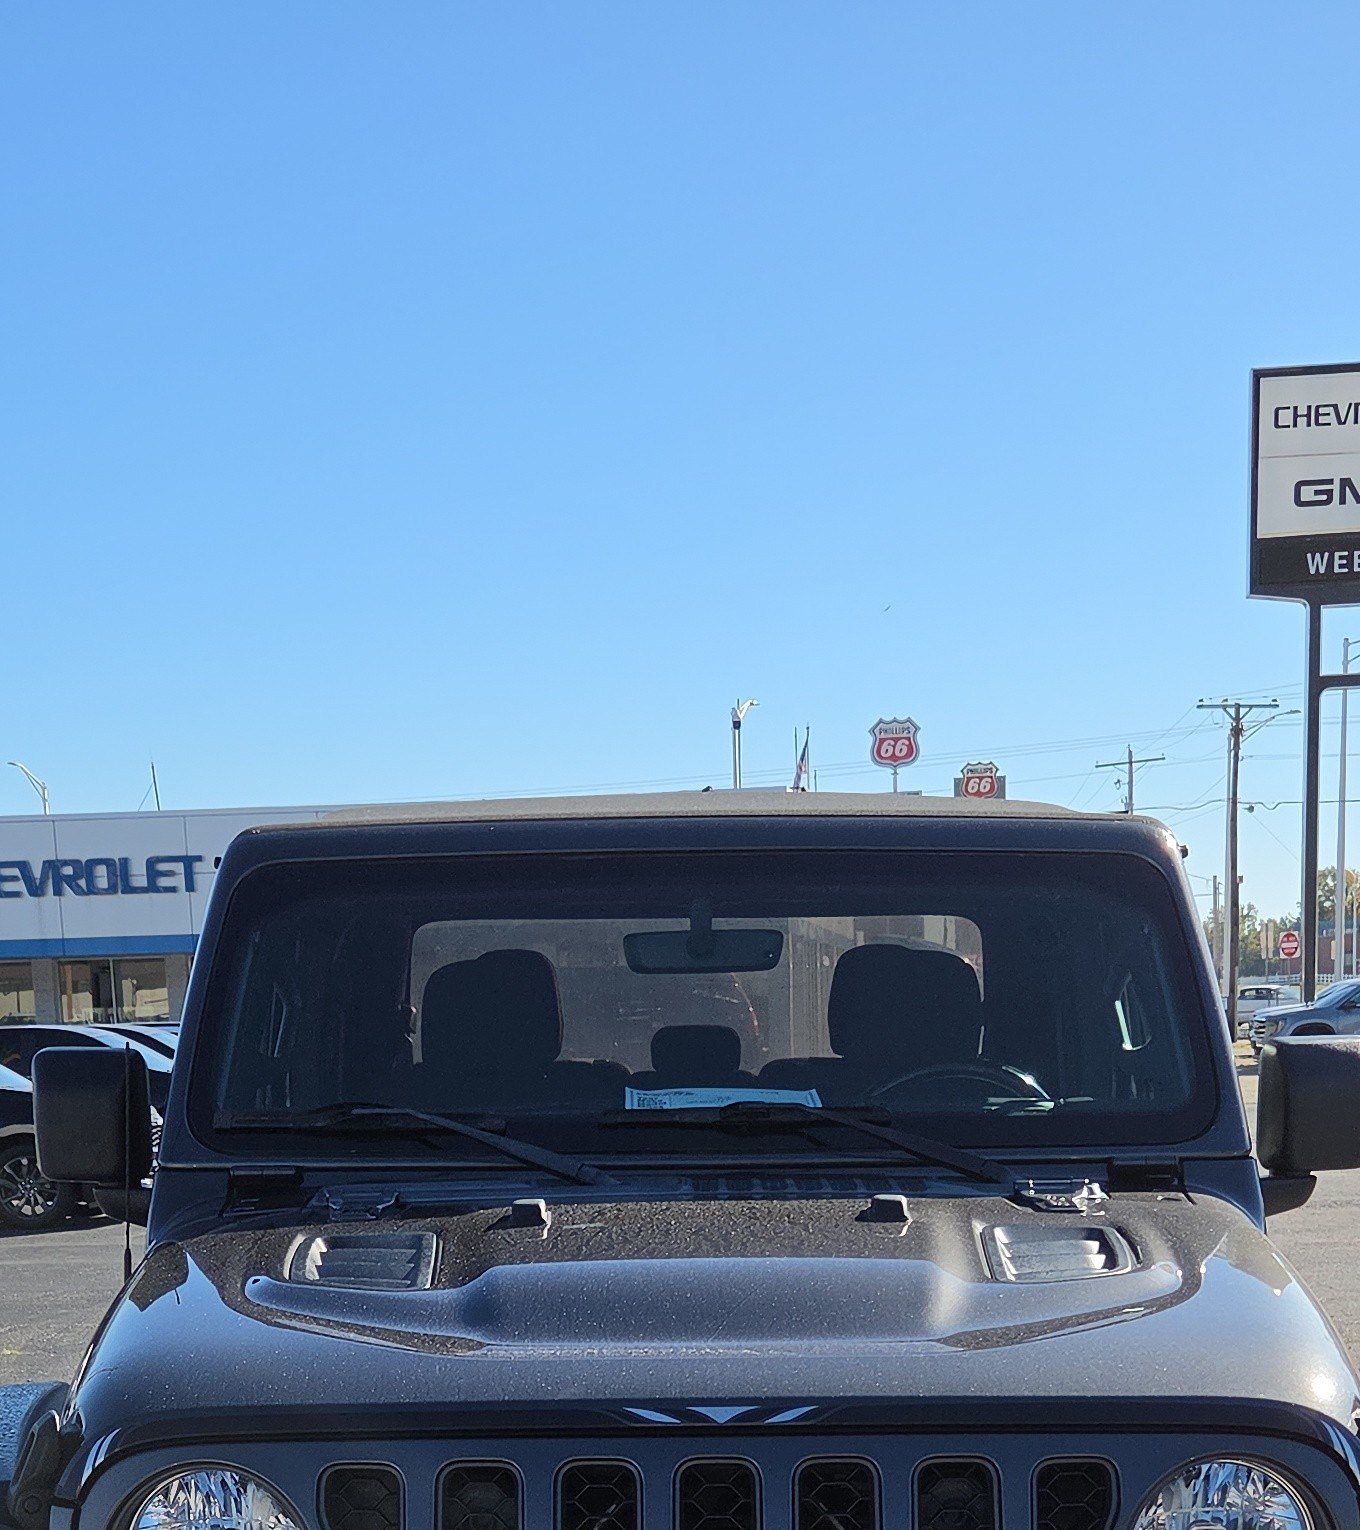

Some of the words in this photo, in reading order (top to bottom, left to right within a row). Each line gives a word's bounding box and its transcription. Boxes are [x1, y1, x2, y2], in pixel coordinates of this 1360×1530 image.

[878, 726, 911, 736] PHILLIPS
[880, 739, 909, 758] 66
[967, 778, 991, 793] 66
